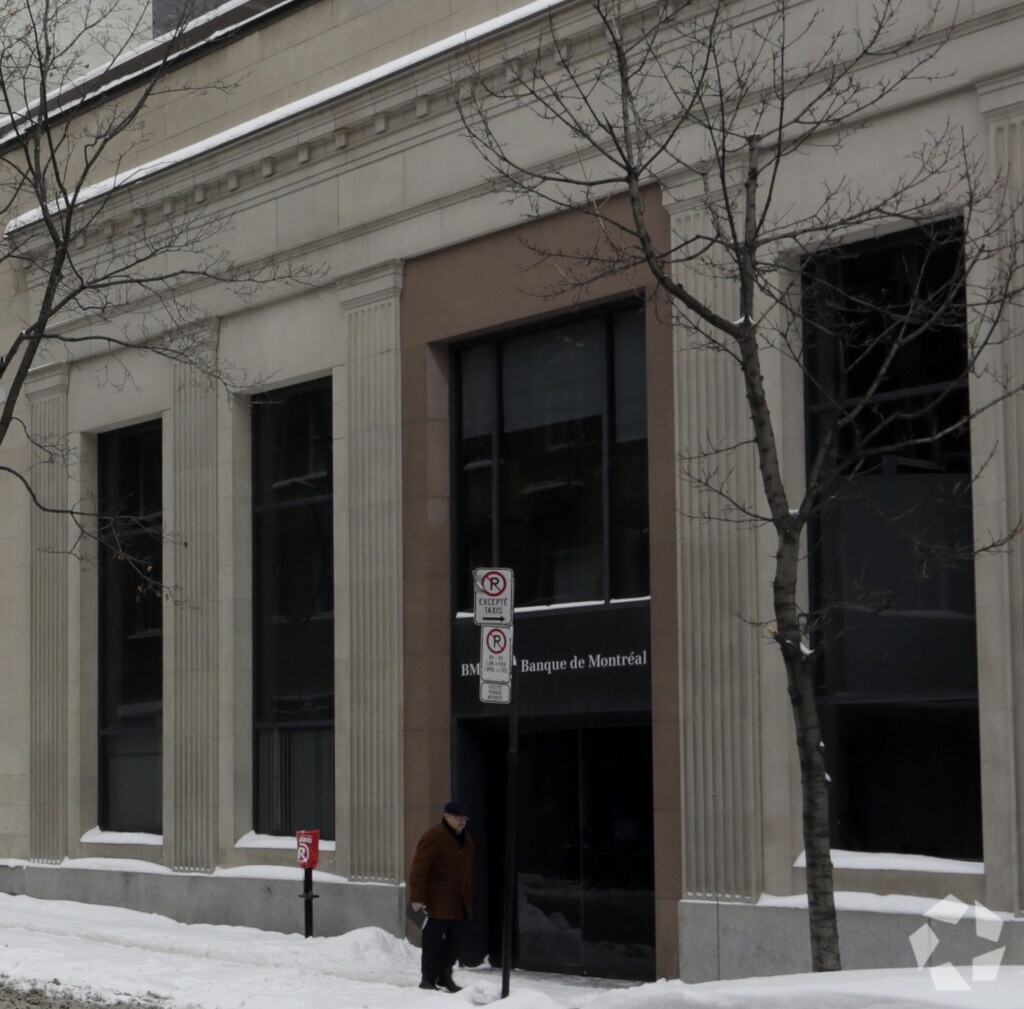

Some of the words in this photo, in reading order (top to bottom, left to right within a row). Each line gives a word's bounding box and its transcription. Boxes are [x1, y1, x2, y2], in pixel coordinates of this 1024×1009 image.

[478, 597, 508, 606] EXCEPTÉ
[484, 606, 503, 614] TAXIS
[461, 663, 480, 676] BM
[521, 659, 567, 674] Banque
[569, 654, 585, 669] de
[588, 650, 647, 668] Montréal
